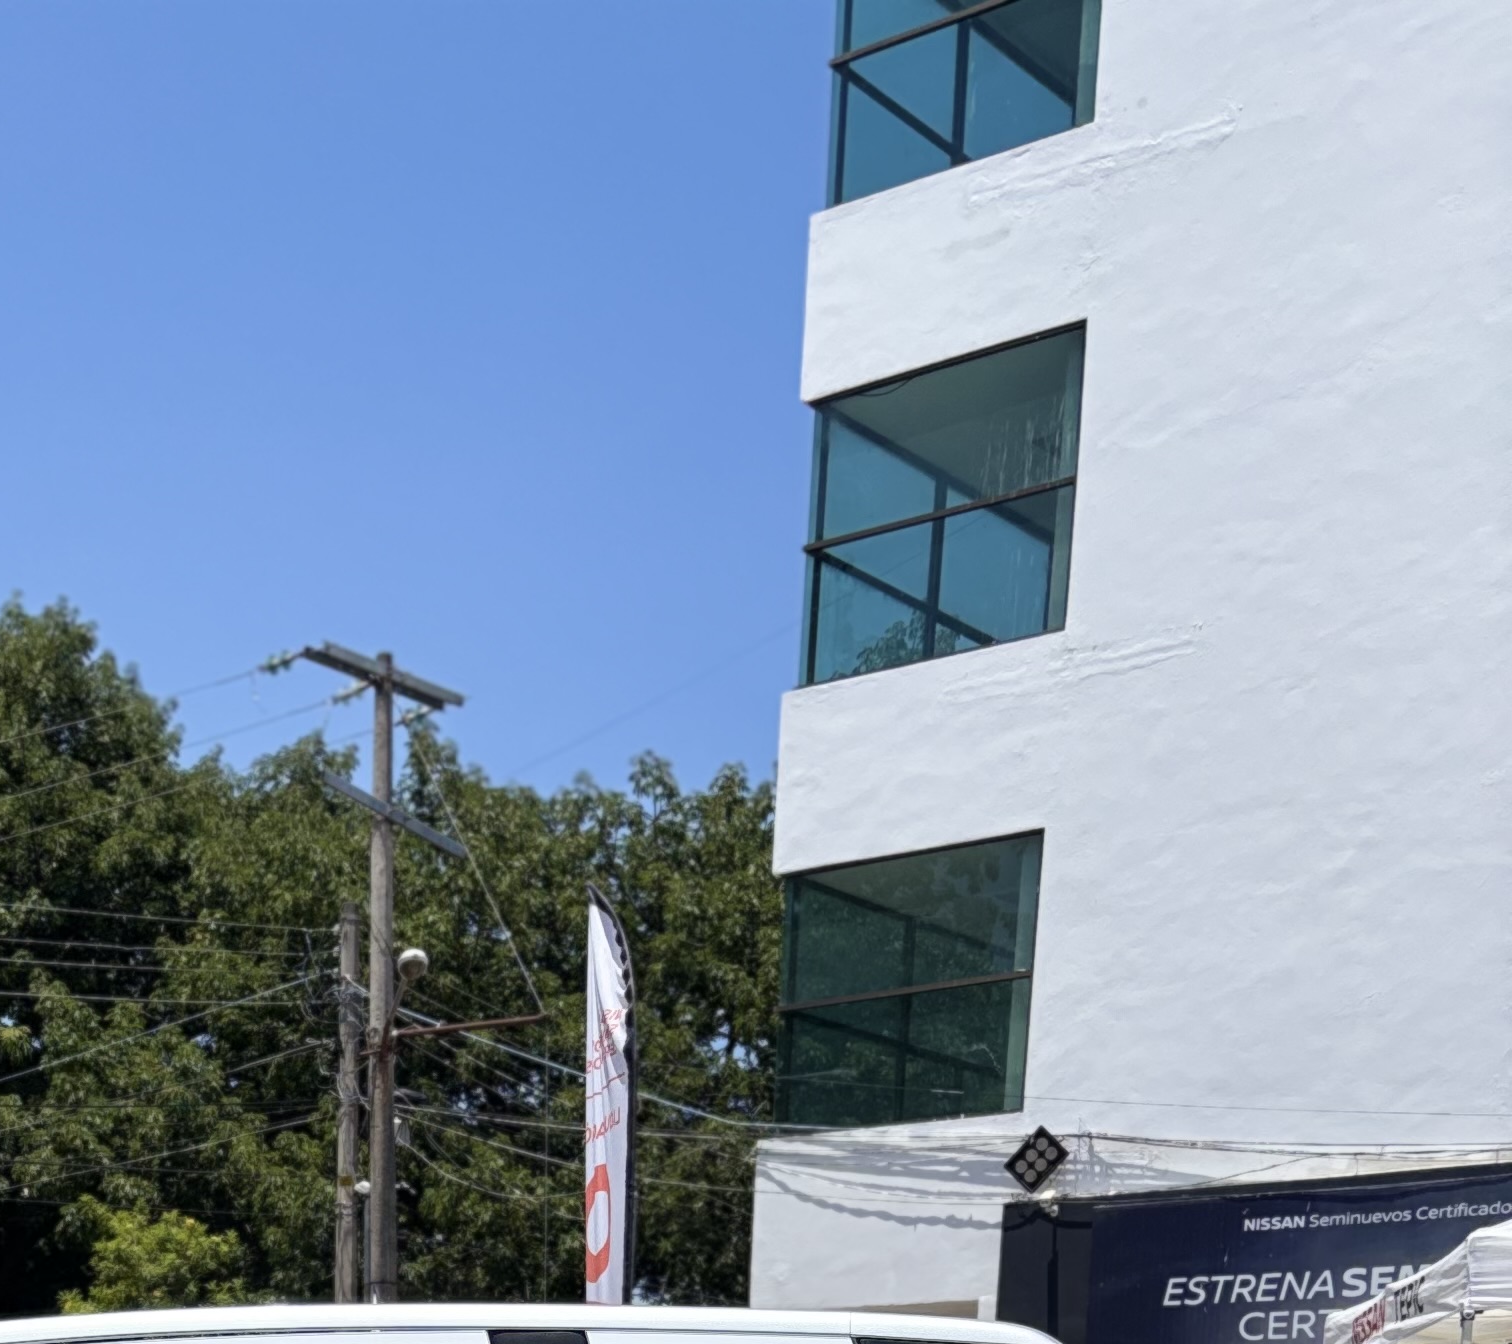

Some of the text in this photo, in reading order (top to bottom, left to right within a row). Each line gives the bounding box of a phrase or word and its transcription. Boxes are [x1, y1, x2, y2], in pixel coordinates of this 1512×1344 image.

[1243, 1215, 1306, 1231] NISSAN
[1309, 1210, 1412, 1227] Seminuevos
[1162, 1269, 1335, 1307] ESTRENA
